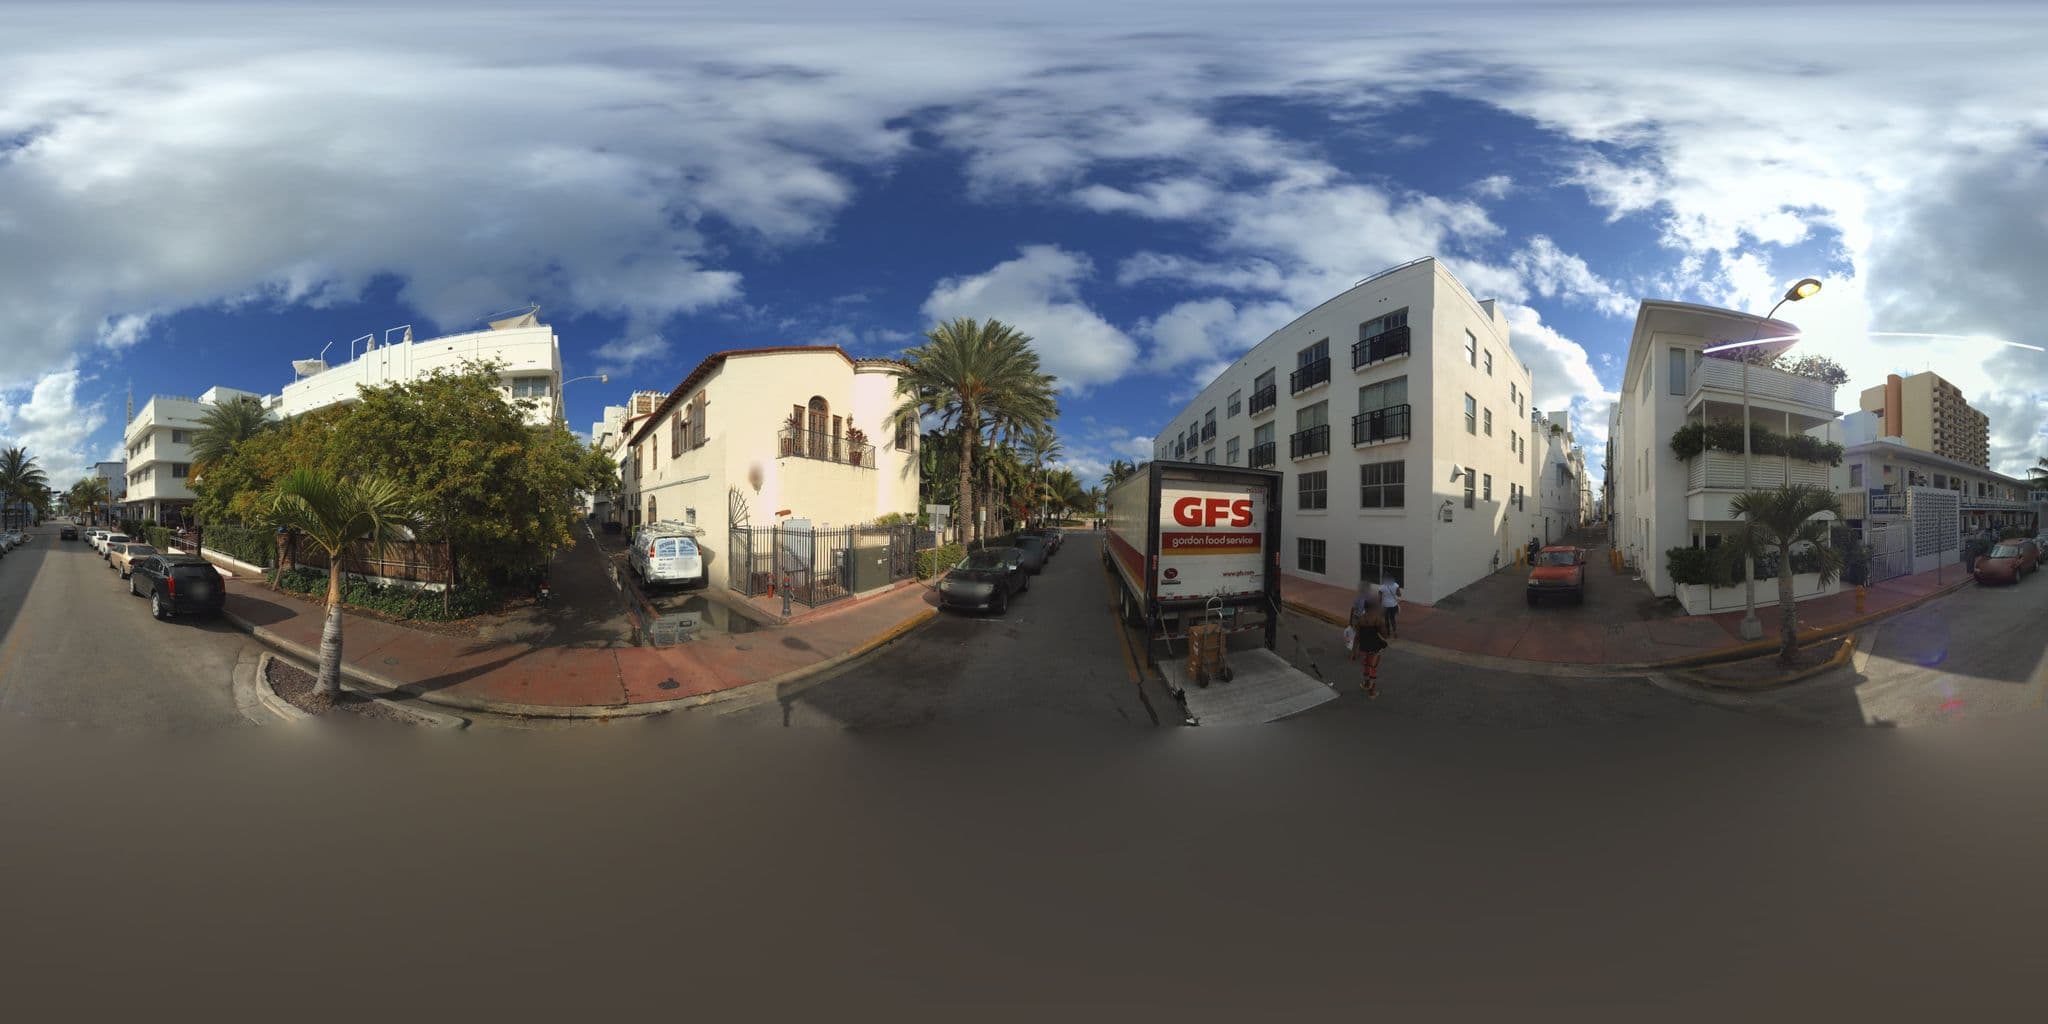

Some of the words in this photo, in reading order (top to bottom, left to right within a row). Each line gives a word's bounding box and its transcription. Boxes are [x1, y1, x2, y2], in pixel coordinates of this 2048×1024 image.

[1173, 497, 1254, 528] GFS
[1172, 536, 1205, 548] gordon
[1205, 535, 1225, 545] food
[1226, 537, 1254, 545] service
